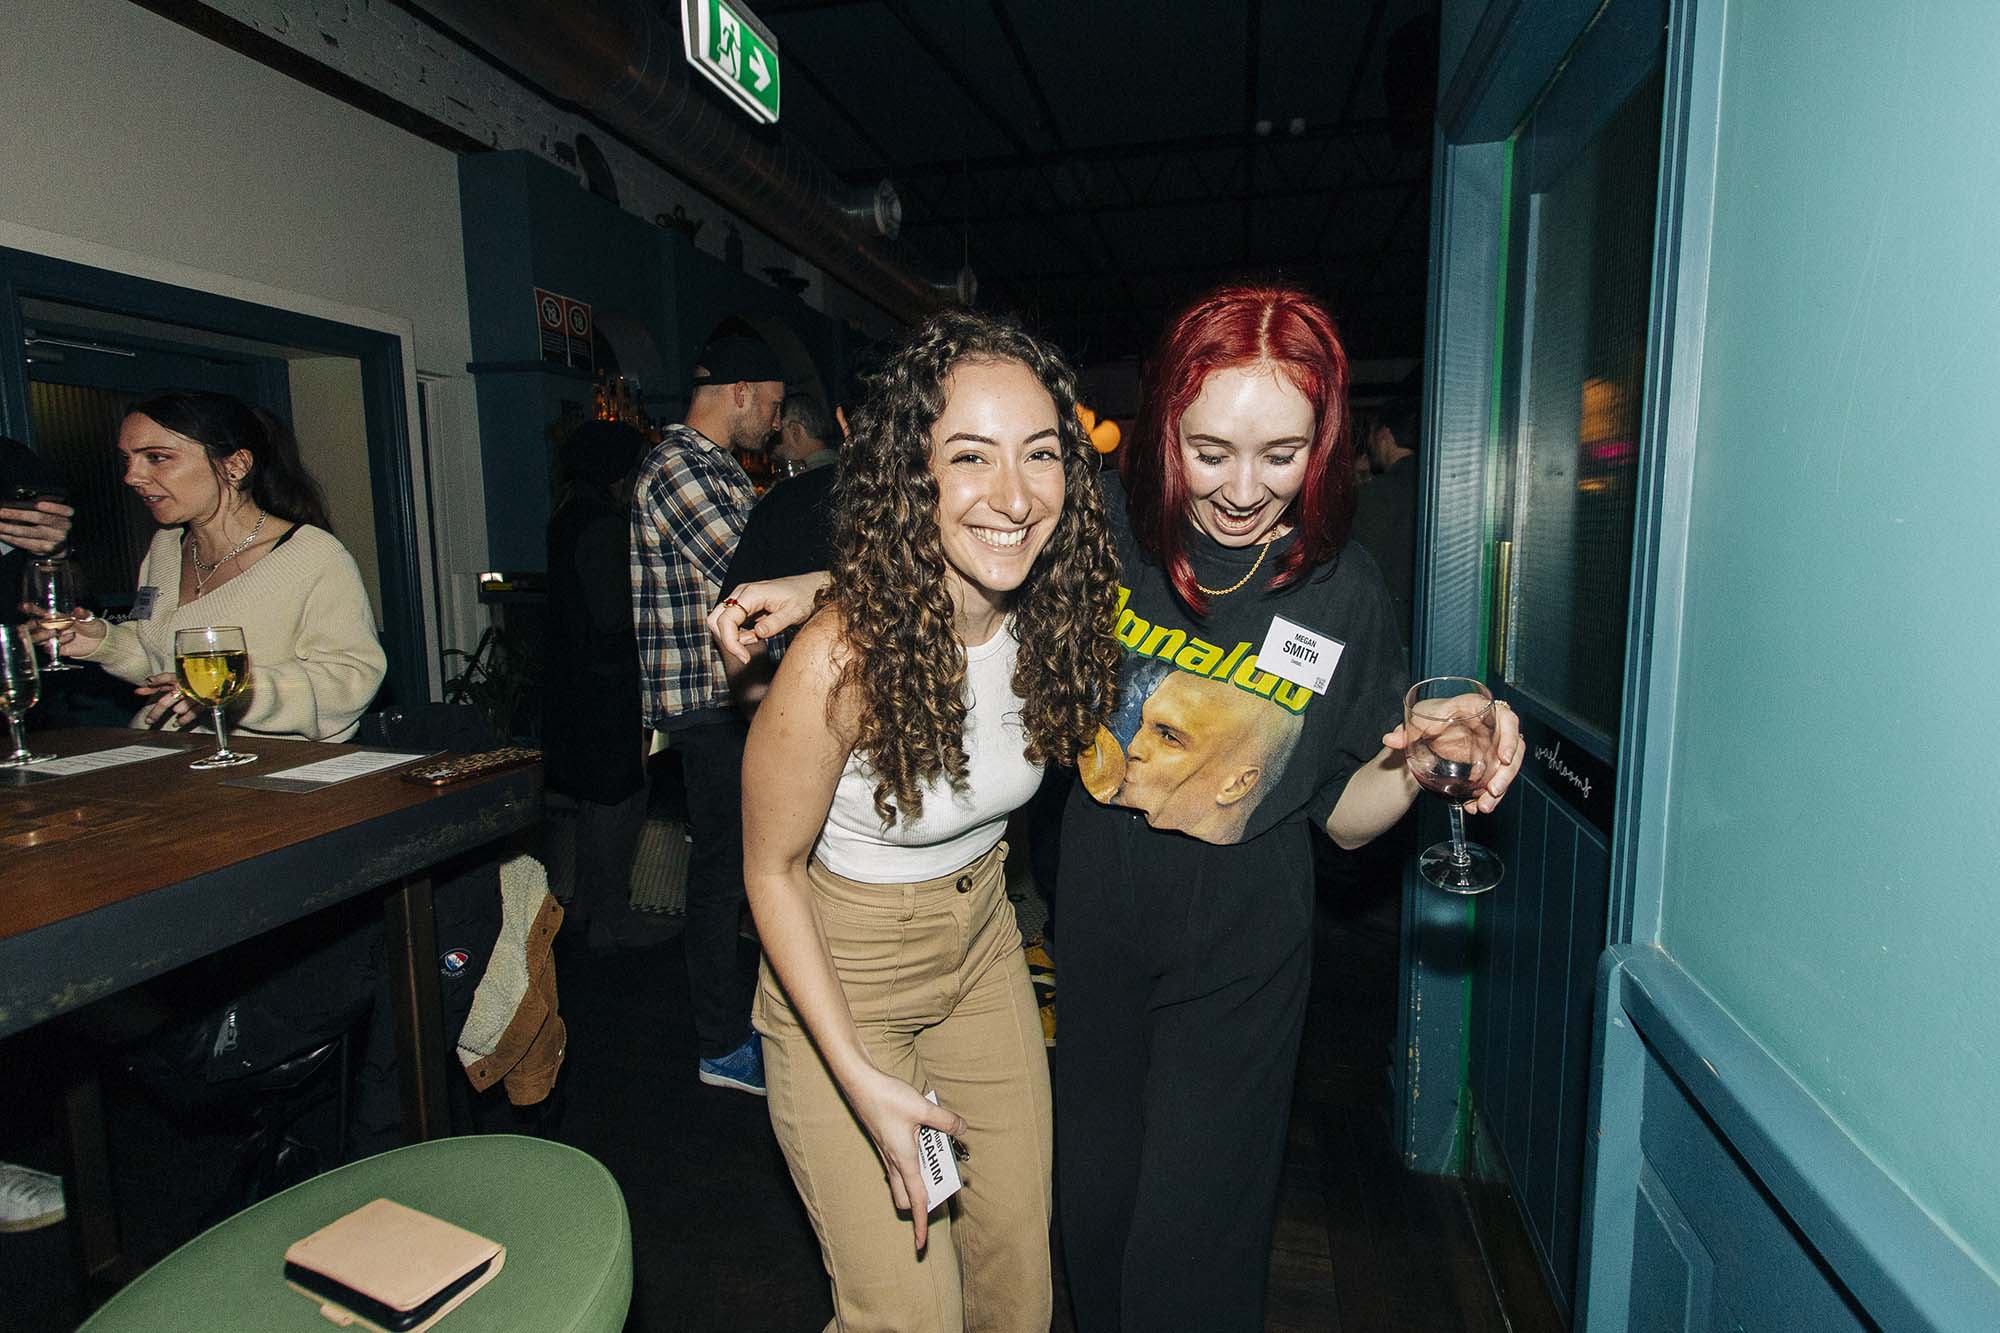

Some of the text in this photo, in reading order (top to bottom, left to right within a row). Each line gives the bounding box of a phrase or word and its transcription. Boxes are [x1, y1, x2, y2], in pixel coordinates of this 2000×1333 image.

[1112, 585, 1315, 714] onaldo
[1283, 640, 1319, 664] SMITH
[1295, 633, 1317, 648] MEGAN
[920, 1125, 945, 1185] BRAHIM
